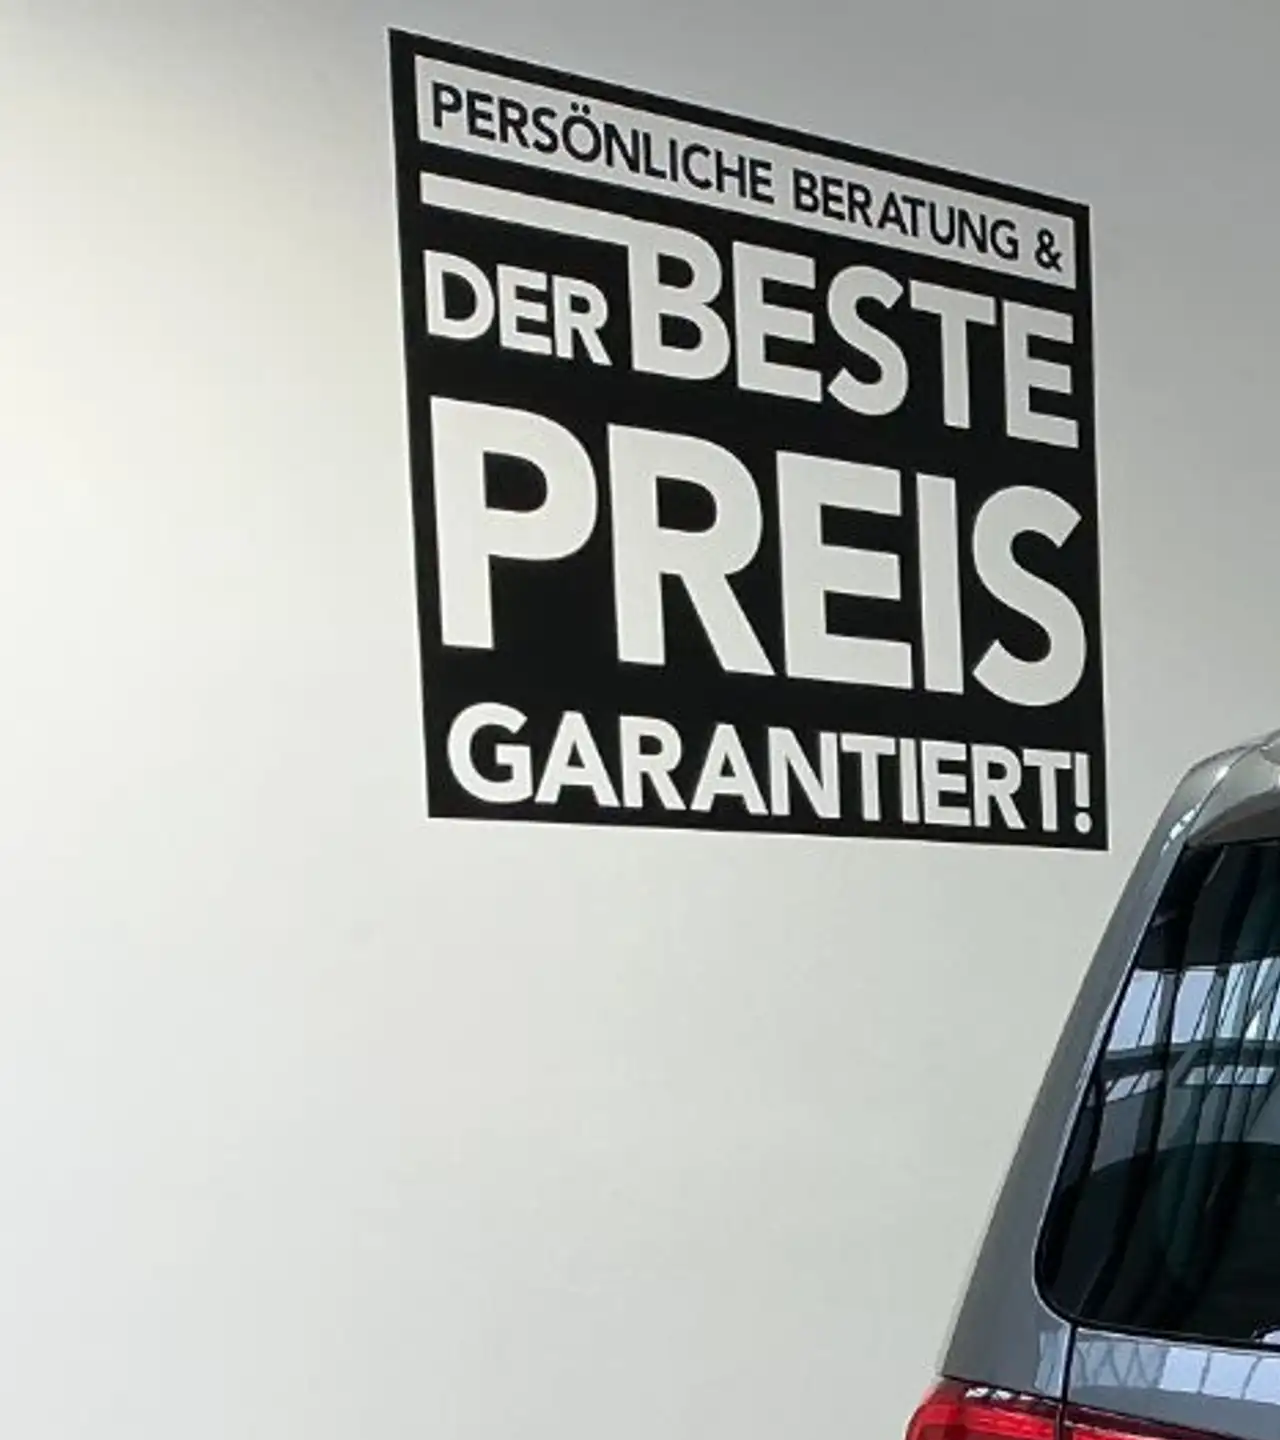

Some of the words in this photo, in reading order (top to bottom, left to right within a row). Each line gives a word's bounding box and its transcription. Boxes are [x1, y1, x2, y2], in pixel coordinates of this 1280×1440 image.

[431, 81, 775, 206] PERSÖNLICHE
[792, 168, 1019, 261] BERATUNG
[1034, 228, 1063, 273] &
[423, 249, 613, 366] DER
[626, 216, 1079, 449] BESTE
[430, 395, 1087, 707] PREIS
[446, 701, 1093, 834] GARANTIERT!
